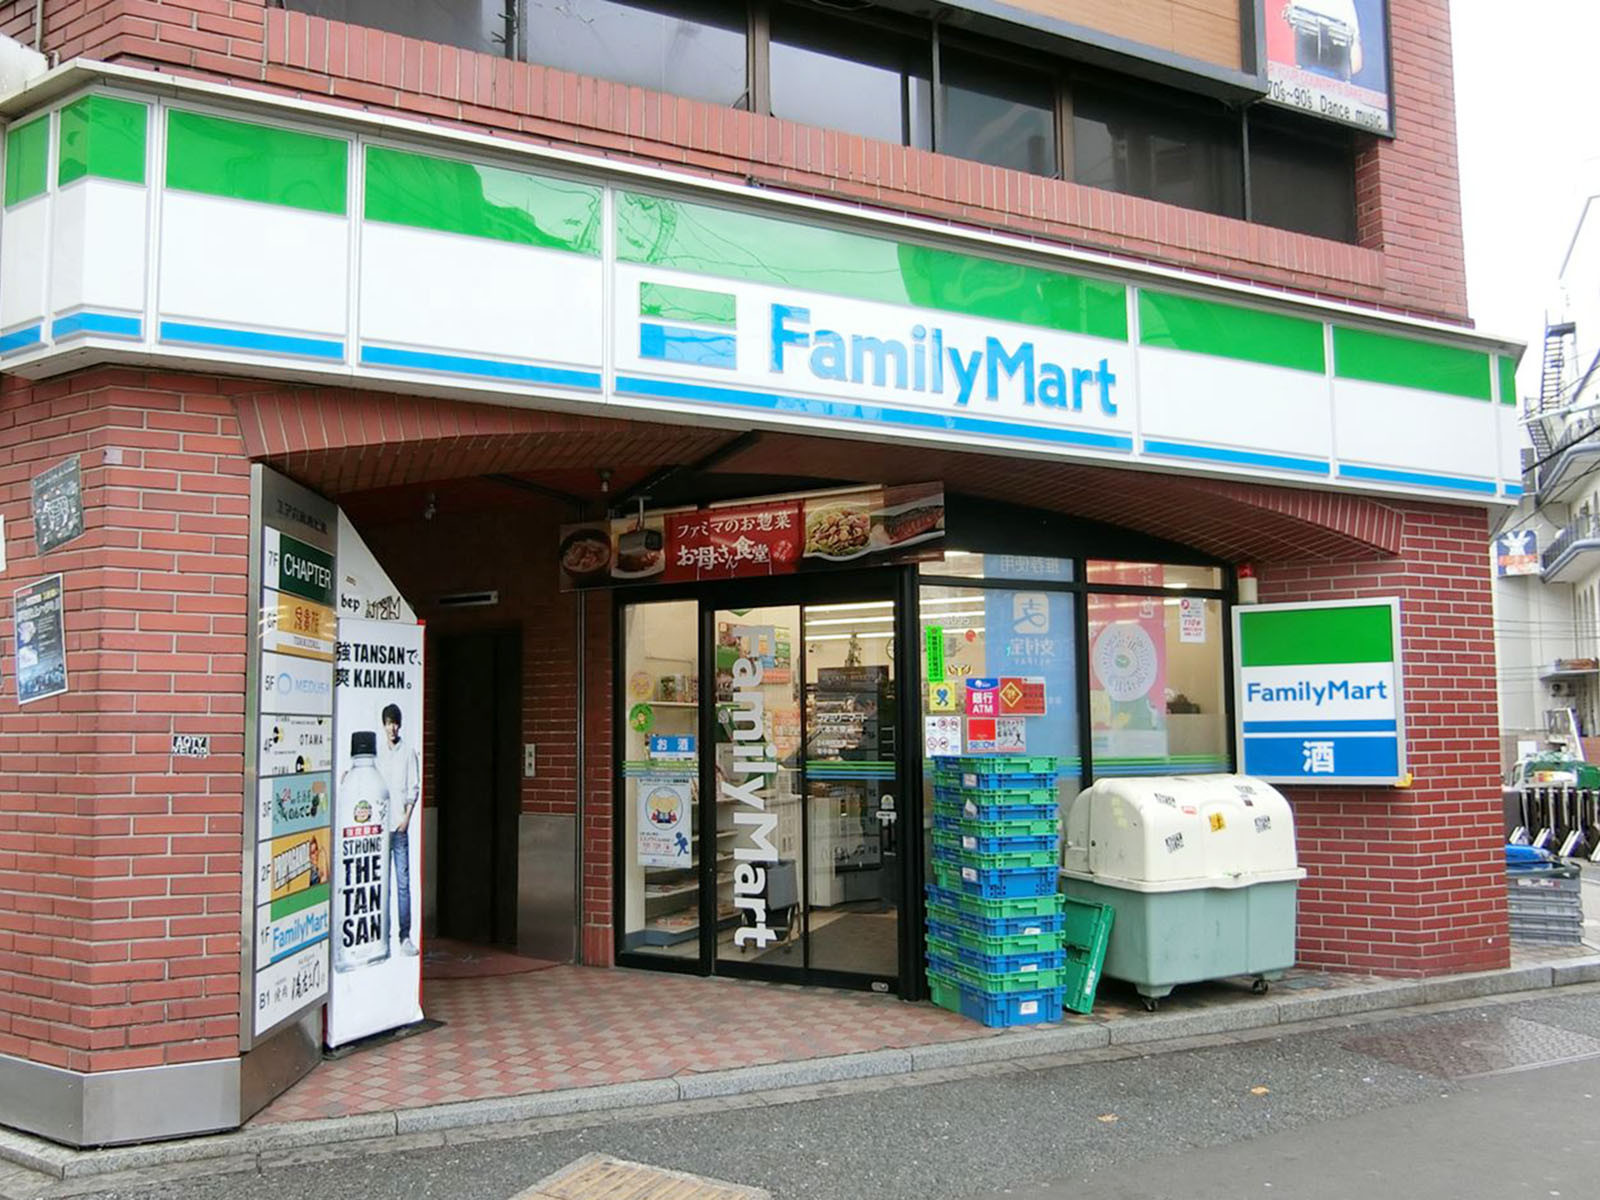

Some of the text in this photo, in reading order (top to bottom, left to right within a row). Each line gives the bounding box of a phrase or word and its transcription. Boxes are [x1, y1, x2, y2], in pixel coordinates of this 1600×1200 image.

[1319, 94, 1350, 119] Dance
[1355, 109, 1383, 129] music
[769, 302, 1118, 418] FamilyMart
[677, 511, 792, 538] ファミマのお惣菜
[677, 535, 771, 570] お母さん食堂
[268, 551, 332, 590] 7F CHAPTER
[265, 674, 275, 691] 5F
[972, 692, 994, 704] 銀行
[1246, 680, 1388, 706] FamilyMart
[972, 704, 994, 714] ATM
[1302, 740, 1335, 773] 酒
[721, 624, 778, 949] FamilyMart
[262, 800, 273, 818] 3F
[342, 836, 382, 856] STRONG
[261, 863, 271, 882] 2F
[343, 854, 381, 886] THE
[343, 884, 381, 917] TAN
[260, 909, 328, 952] 1F FamilyMart
[343, 913, 381, 948] SAN
[259, 990, 270, 1010] B1
